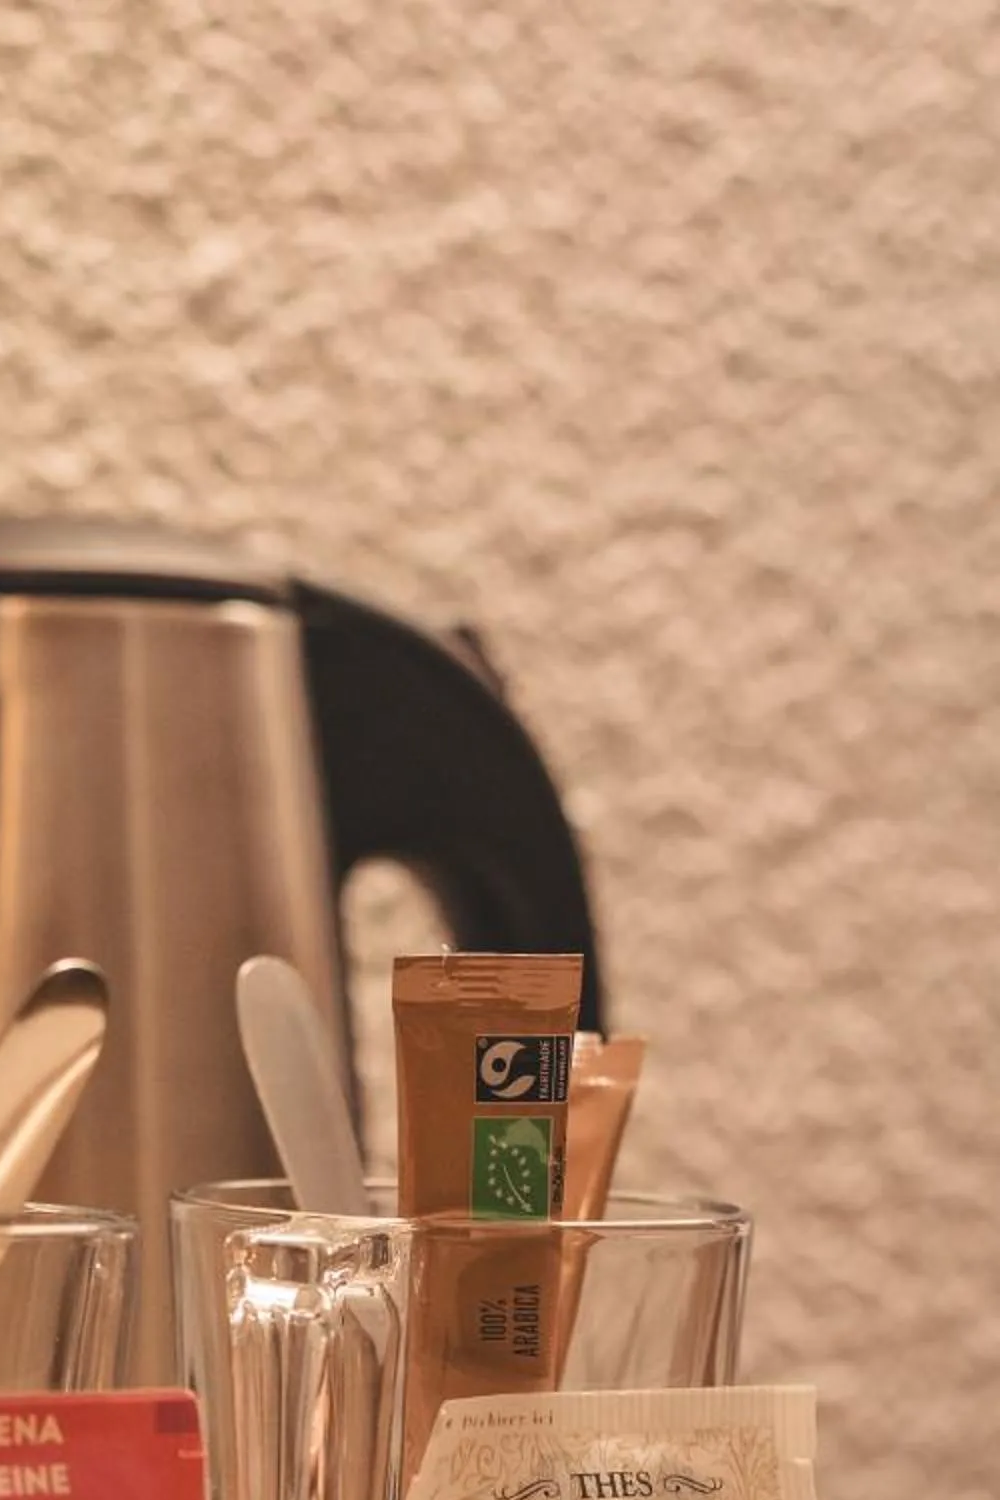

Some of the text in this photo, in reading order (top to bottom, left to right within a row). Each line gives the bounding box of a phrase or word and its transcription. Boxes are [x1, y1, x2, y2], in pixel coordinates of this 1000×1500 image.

[480, 1299, 507, 1342] 100%
[513, 1284, 540, 1357] ARABICA
[571, 1471, 654, 1500] THES
